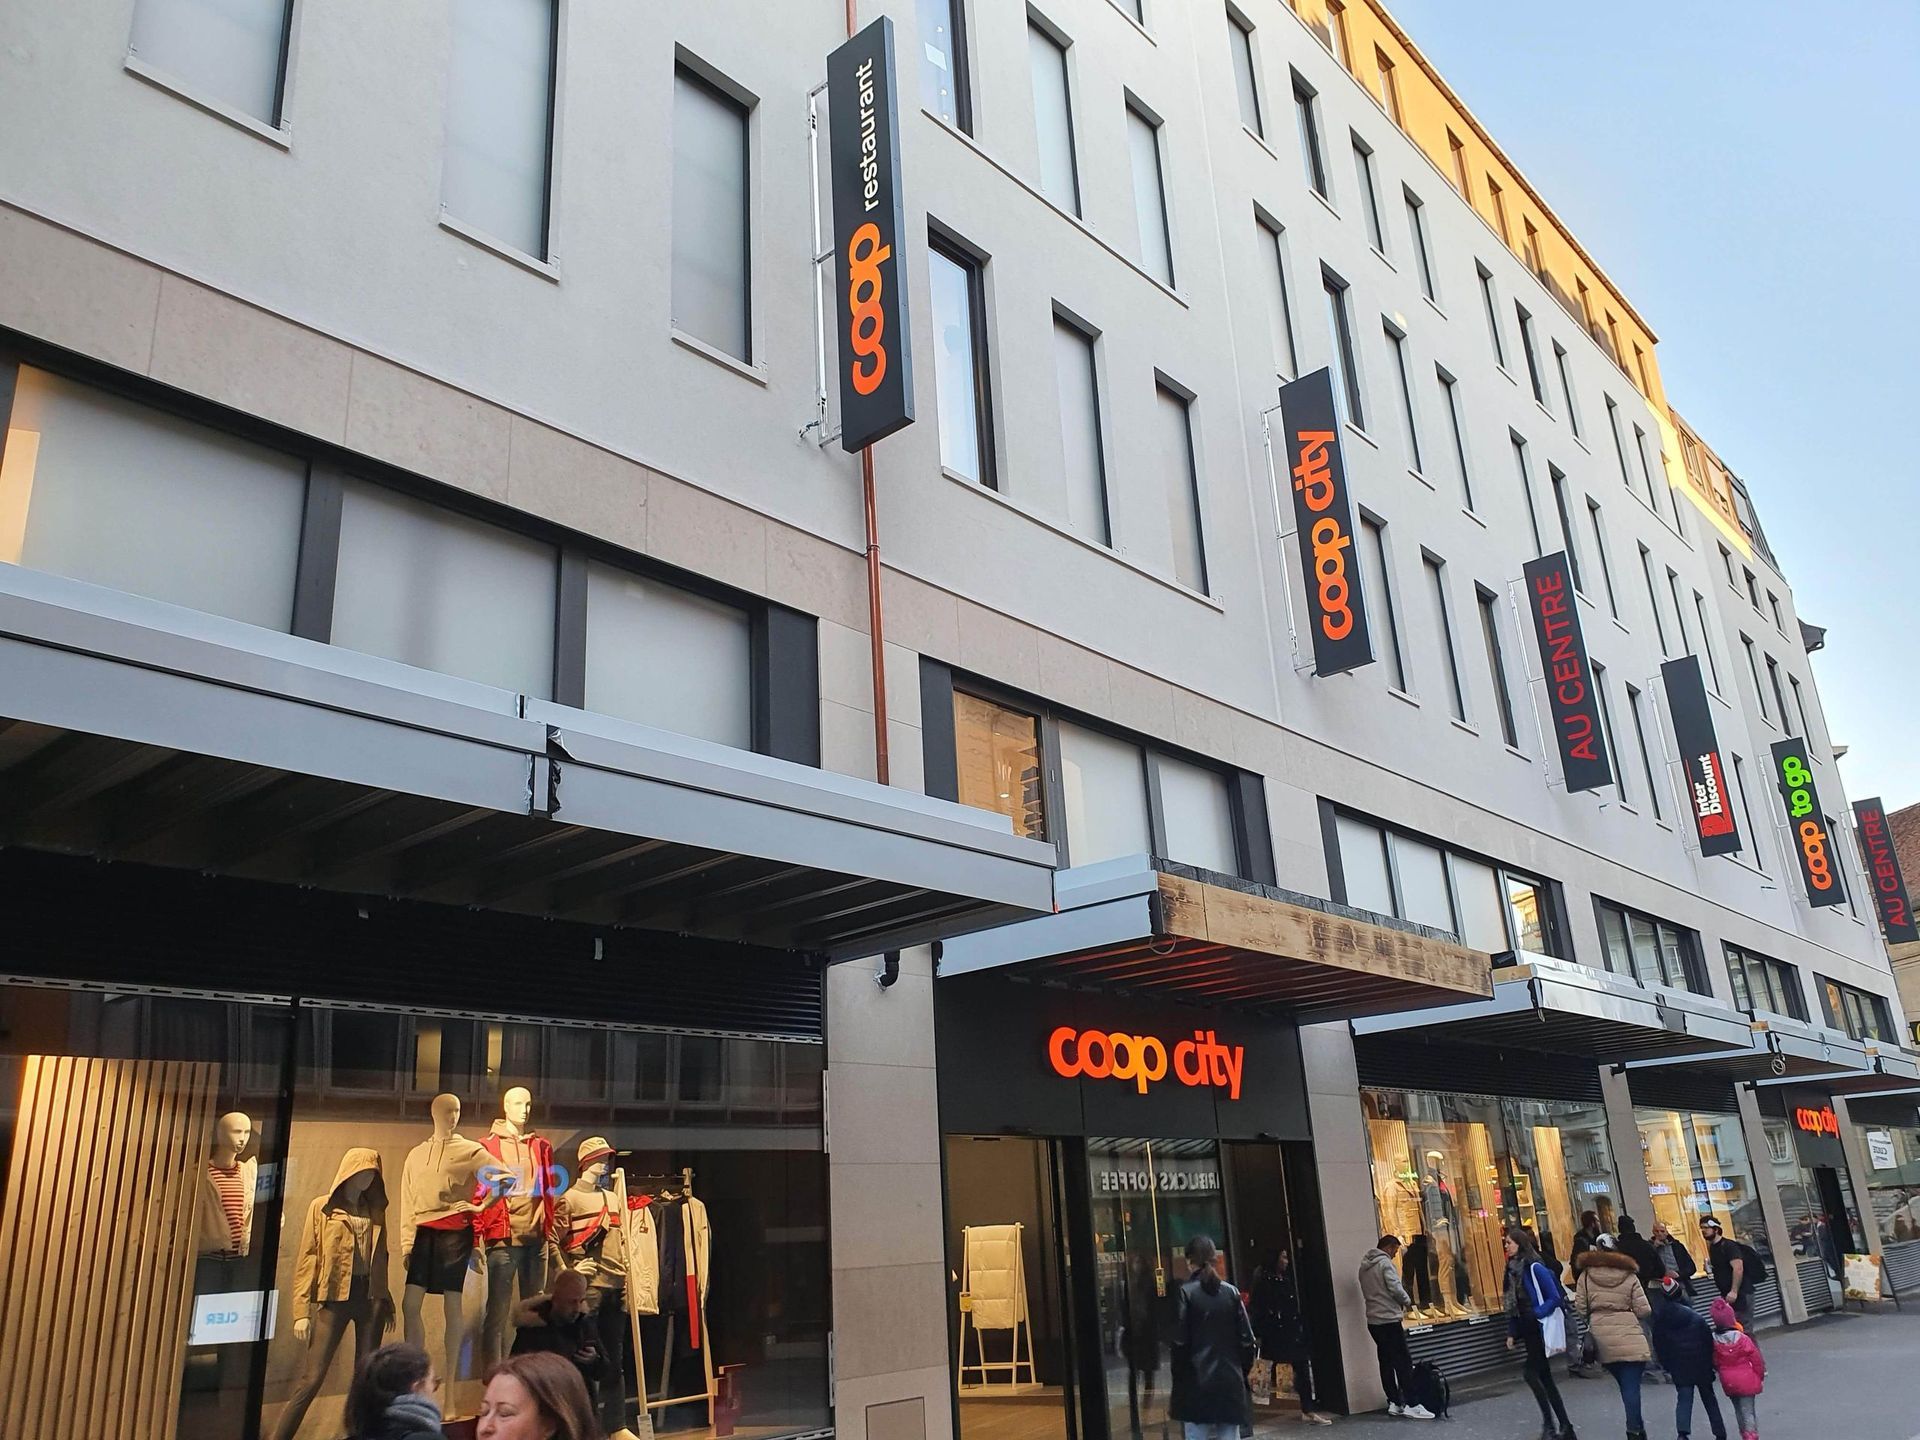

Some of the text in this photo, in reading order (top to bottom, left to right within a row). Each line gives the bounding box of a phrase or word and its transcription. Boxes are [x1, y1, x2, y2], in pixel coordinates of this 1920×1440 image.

[848, 57, 892, 396] coop restaurant
[1293, 431, 1354, 641] coop city
[1535, 570, 1598, 761] AU CENTRE
[1694, 782, 1711, 817] Inter
[1698, 753, 1723, 815] Discount
[1782, 756, 1833, 891] coop to go
[1859, 807, 1909, 927] AU CENTRE
[1049, 1026, 1244, 1100] coop city
[1796, 1106, 1840, 1139] coop city
